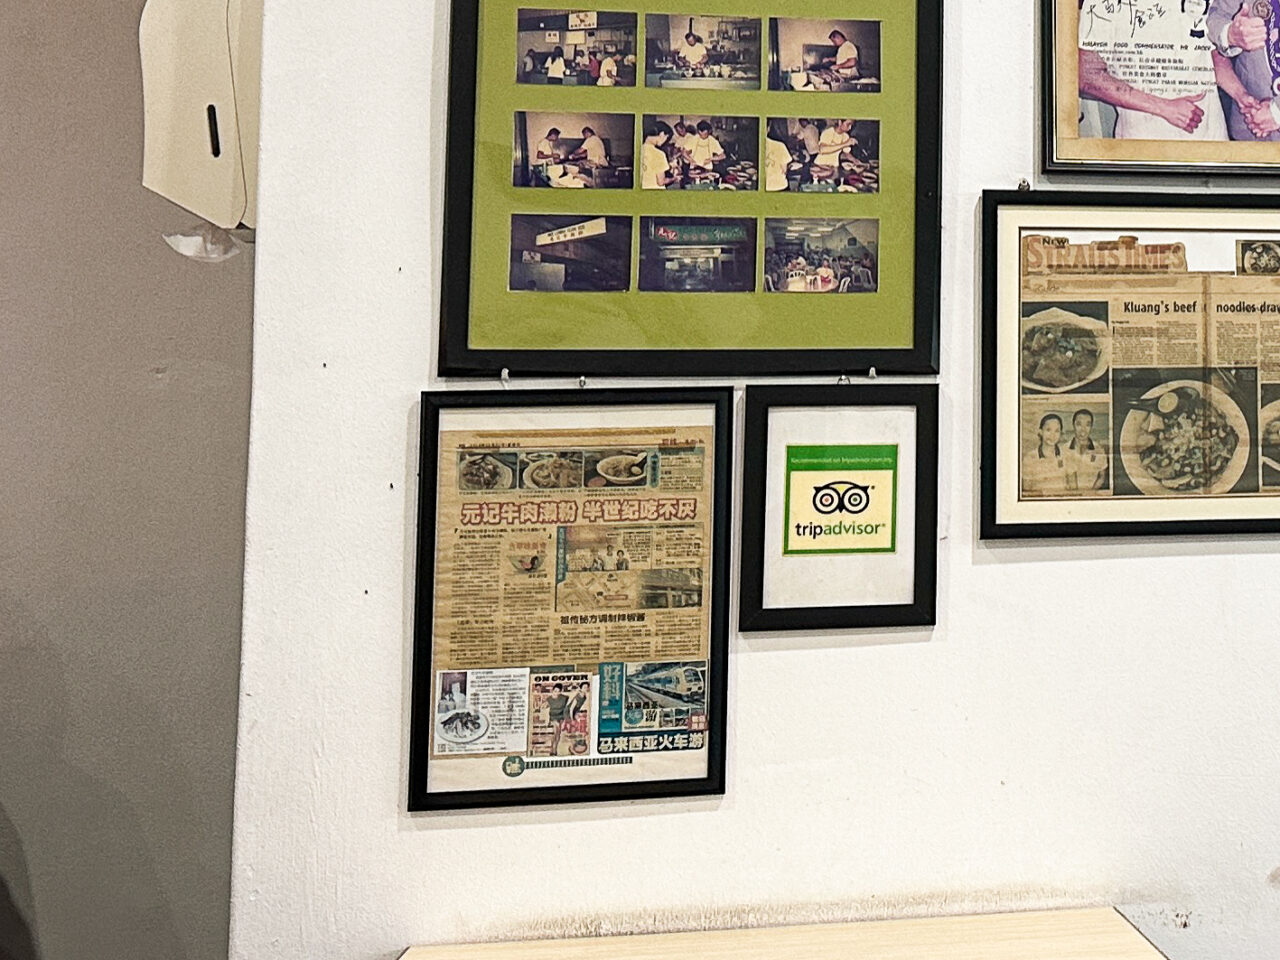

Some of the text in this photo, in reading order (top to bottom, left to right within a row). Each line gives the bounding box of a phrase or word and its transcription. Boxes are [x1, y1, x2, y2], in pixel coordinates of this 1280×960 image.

[1123, 301, 1170, 315] Kluang's
[1173, 300, 1198, 313] beef
[1216, 301, 1257, 313] noodles
[795, 521, 881, 539] tripadvisor
